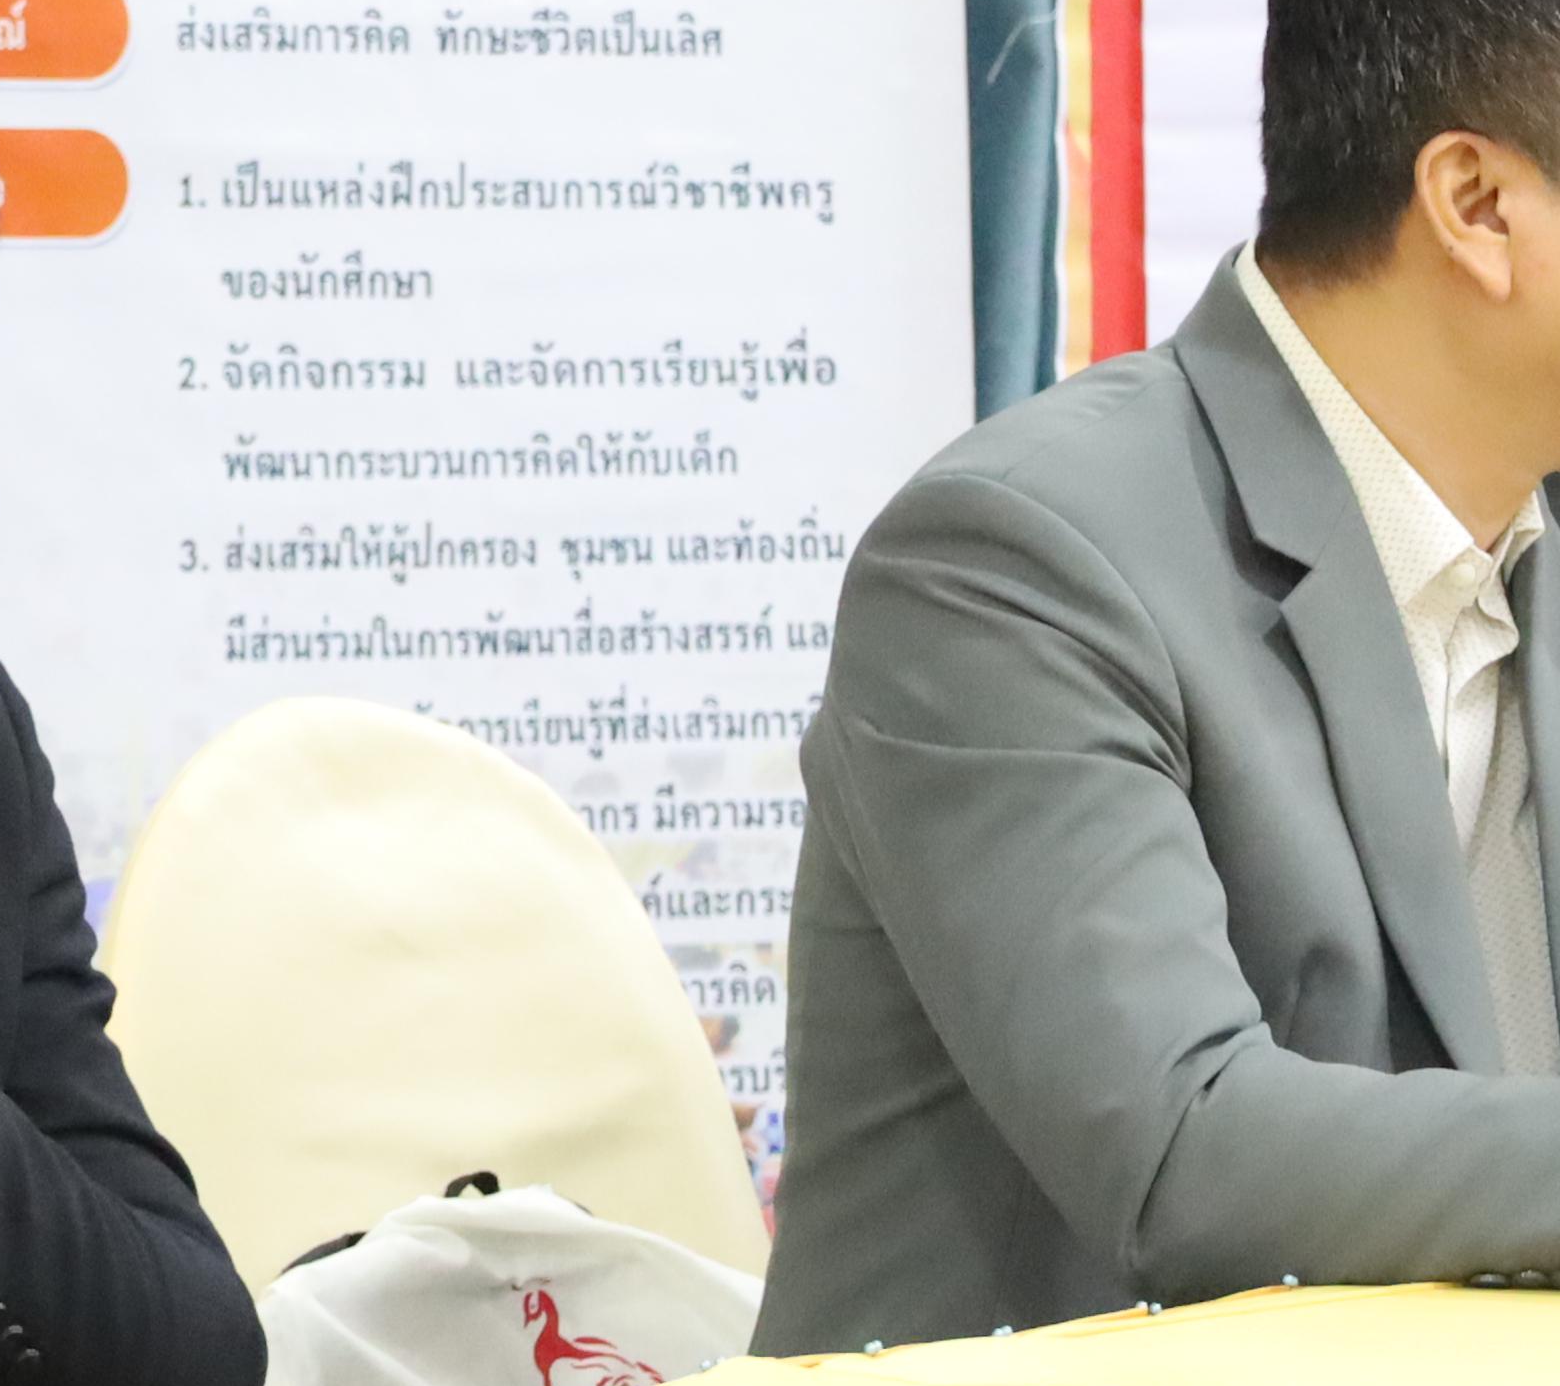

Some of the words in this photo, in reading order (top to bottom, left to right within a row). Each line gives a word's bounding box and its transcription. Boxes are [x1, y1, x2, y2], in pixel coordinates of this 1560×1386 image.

[176, 5, 411, 57] ส่งเสริมการคิด
[220, 249, 435, 300] ของนักศึกษา
[222, 343, 427, 390] จัดกิจกรรม
[560, 533, 654, 582] ชุมชน
[787, 620, 835, 651] แล
[578, 802, 640, 833] ากร
[653, 783, 809, 832] มีความรอ
